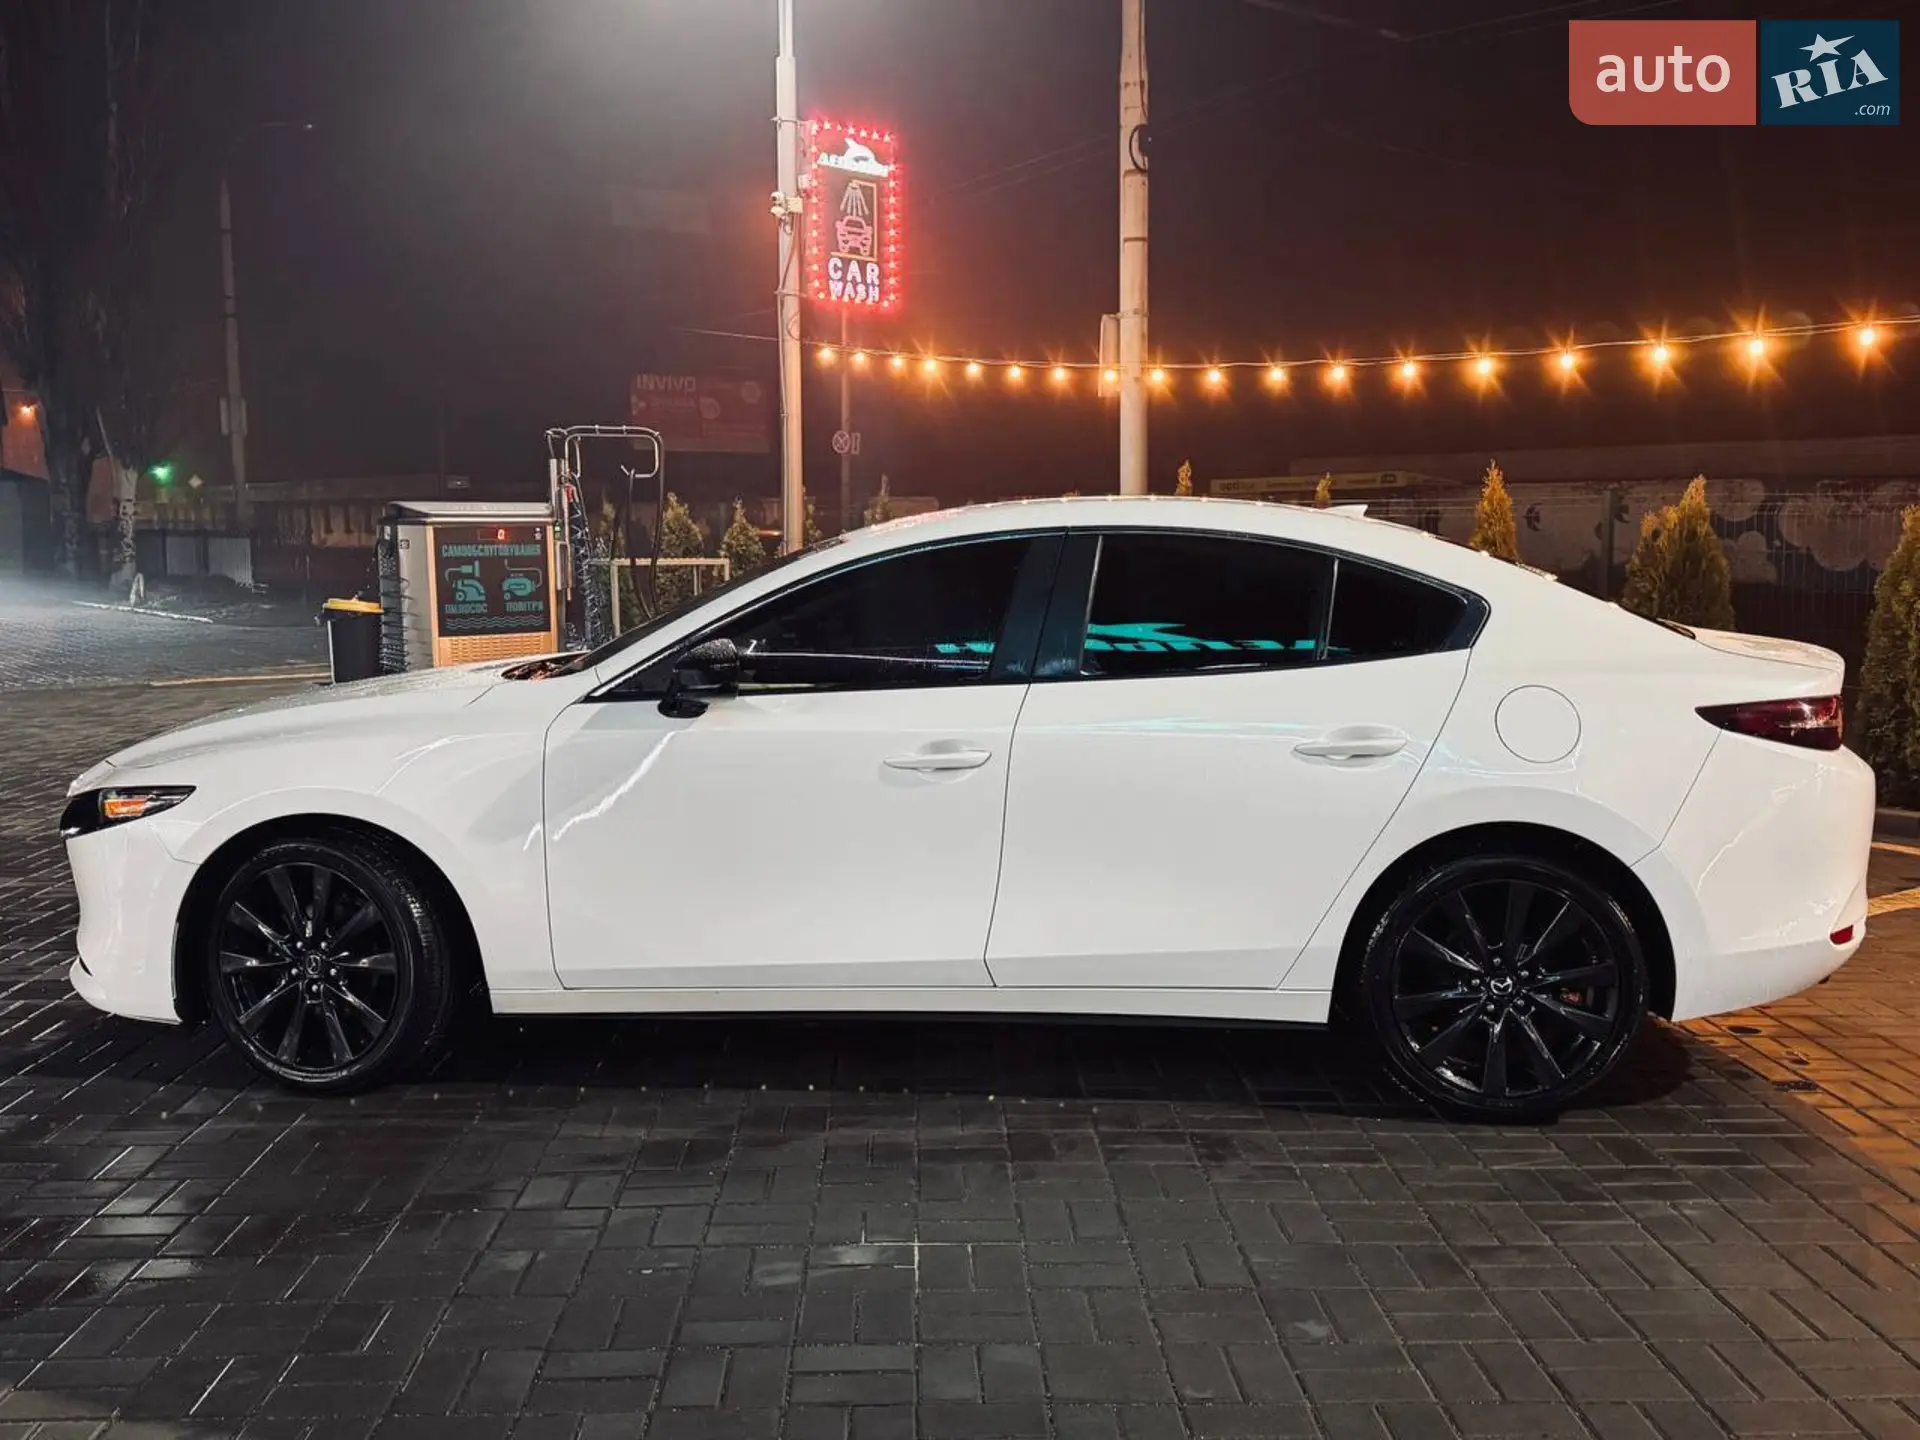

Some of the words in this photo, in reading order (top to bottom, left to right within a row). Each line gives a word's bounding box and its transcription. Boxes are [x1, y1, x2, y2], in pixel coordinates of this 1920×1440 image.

[828, 257, 880, 285] CAR
[829, 280, 880, 304] WASH
[637, 373, 696, 392] INVIVO
